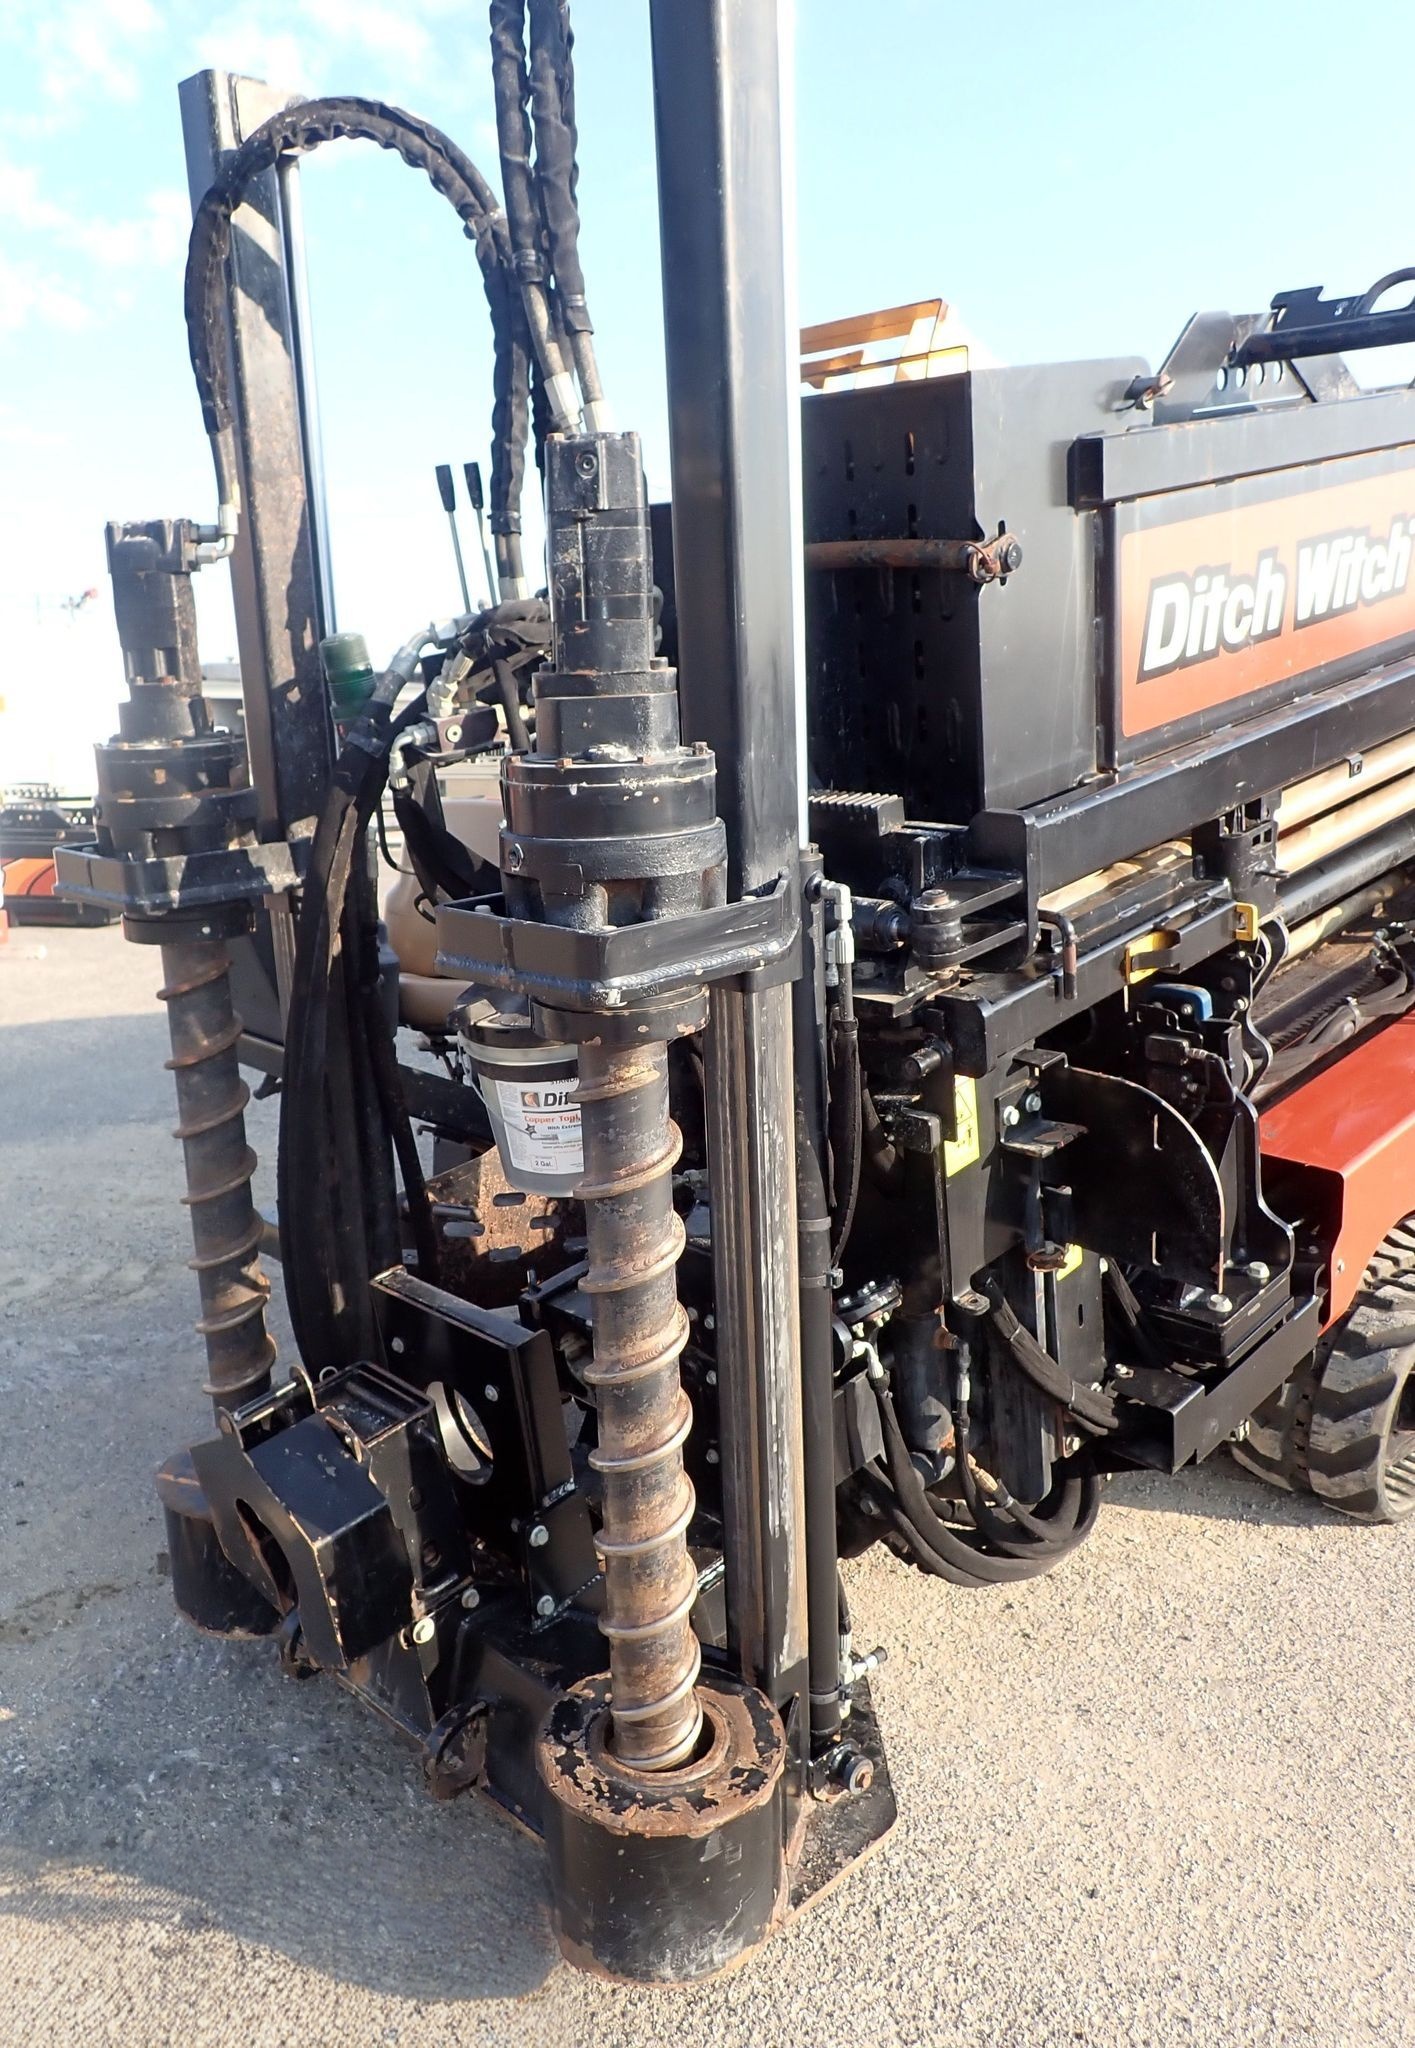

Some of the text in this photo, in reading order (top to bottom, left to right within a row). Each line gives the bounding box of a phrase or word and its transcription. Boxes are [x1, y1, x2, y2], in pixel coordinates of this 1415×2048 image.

[1140, 519, 1412, 674] Ditch Witch
[524, 1115, 555, 1124] Copper
